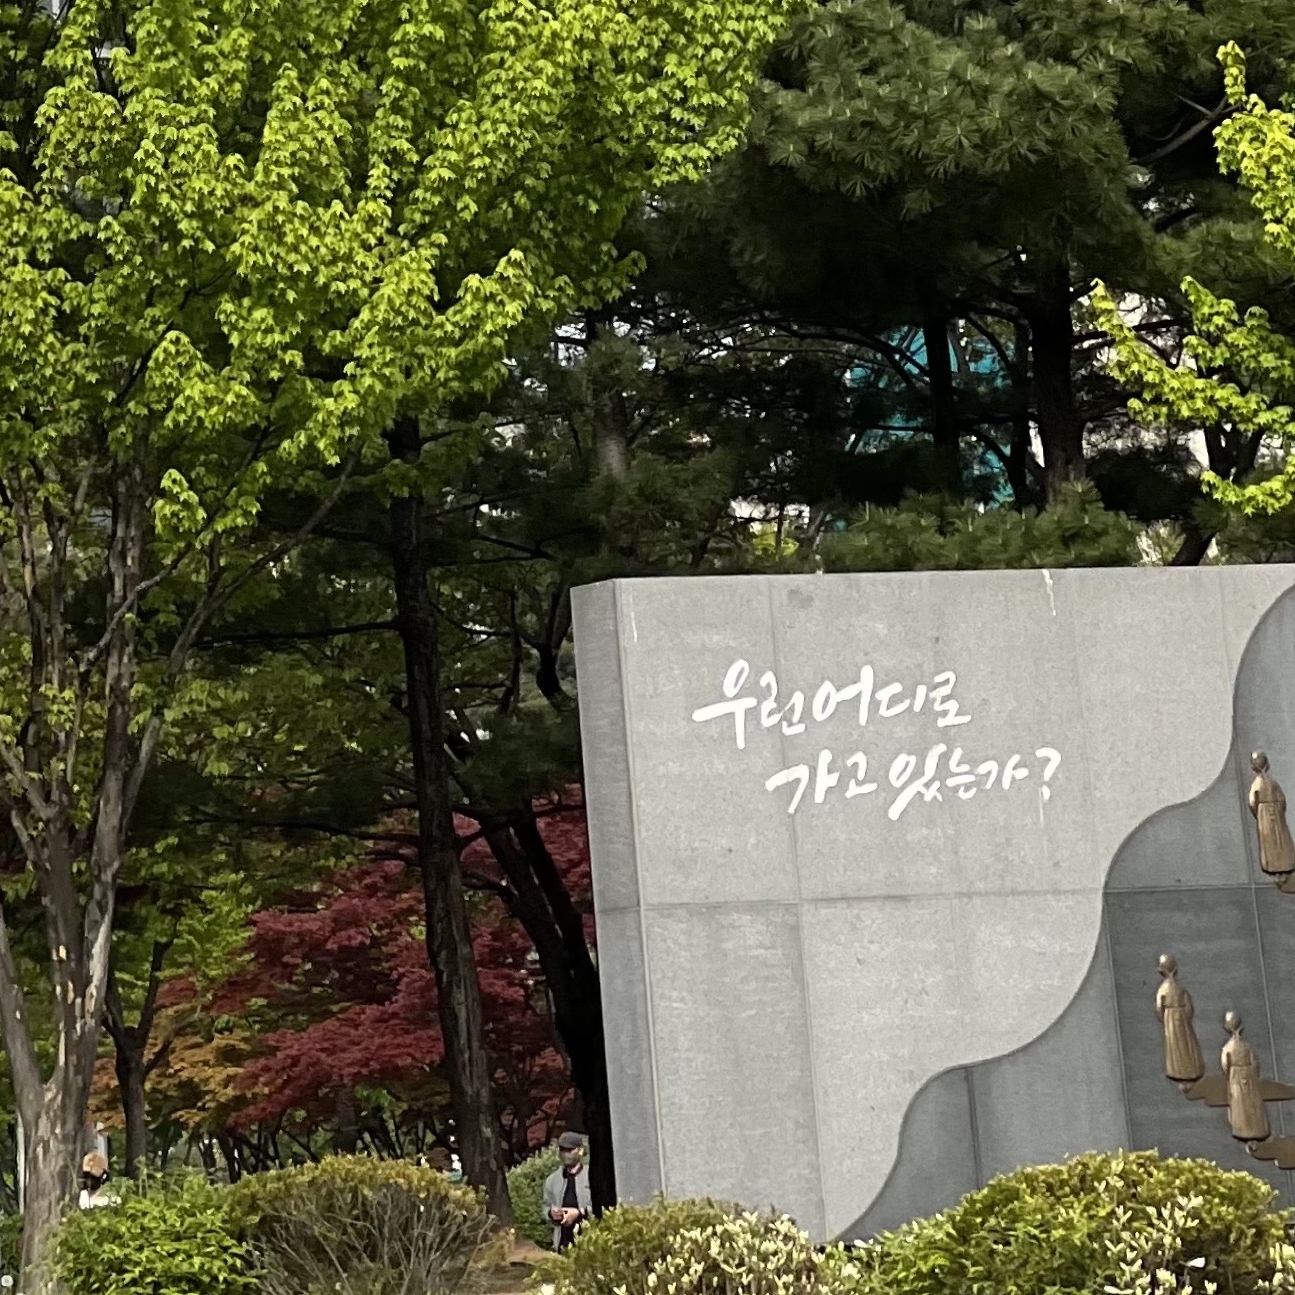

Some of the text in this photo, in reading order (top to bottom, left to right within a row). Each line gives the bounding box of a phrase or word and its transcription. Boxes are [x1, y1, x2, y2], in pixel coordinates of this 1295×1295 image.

[692, 659, 971, 749] 우린 어디로
[765, 743, 1062, 821] 가고 있는가?
